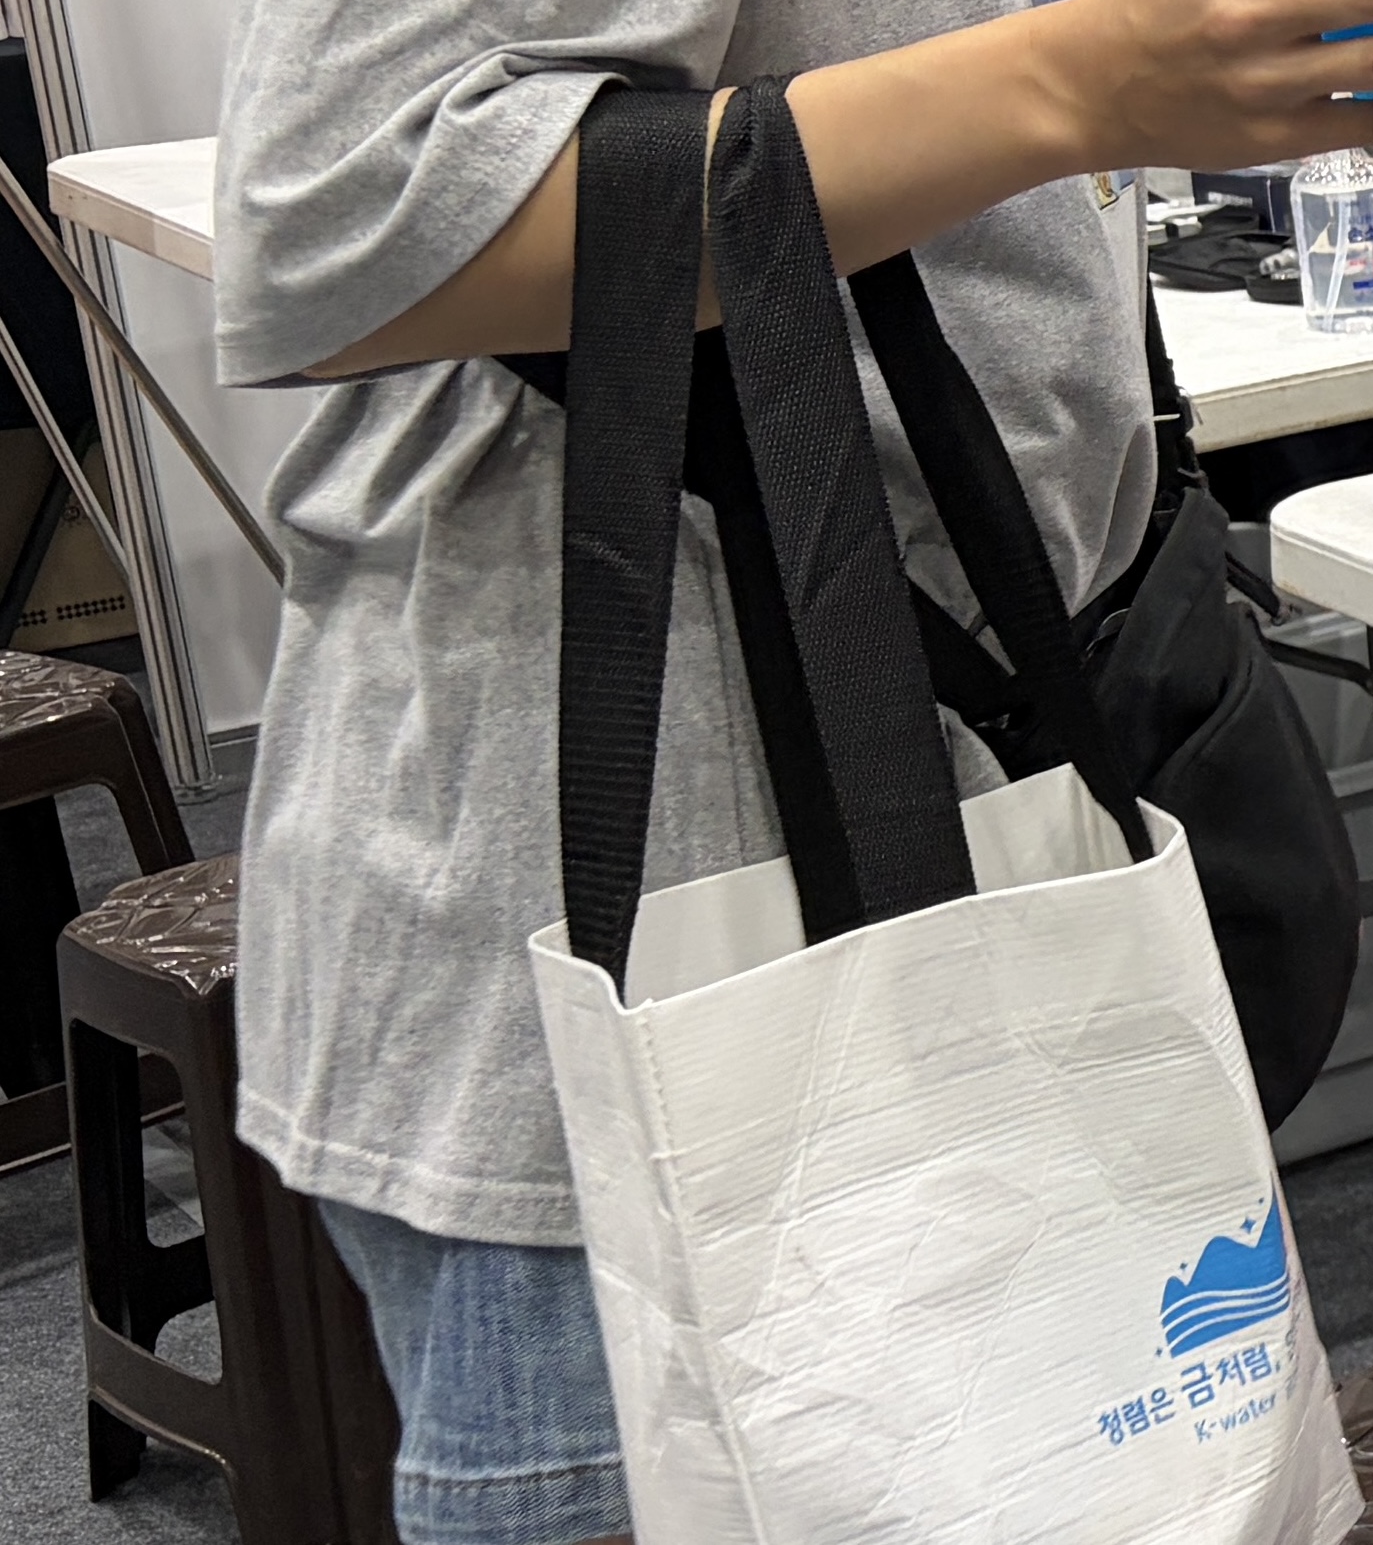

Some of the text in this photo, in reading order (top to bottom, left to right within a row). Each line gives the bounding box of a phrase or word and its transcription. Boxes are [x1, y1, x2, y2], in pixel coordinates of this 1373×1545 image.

[1096, 1387, 1177, 1446] 청렴은
[1180, 1341, 1282, 1410] 금처럼,
[1194, 1393, 1277, 1444] K-water
